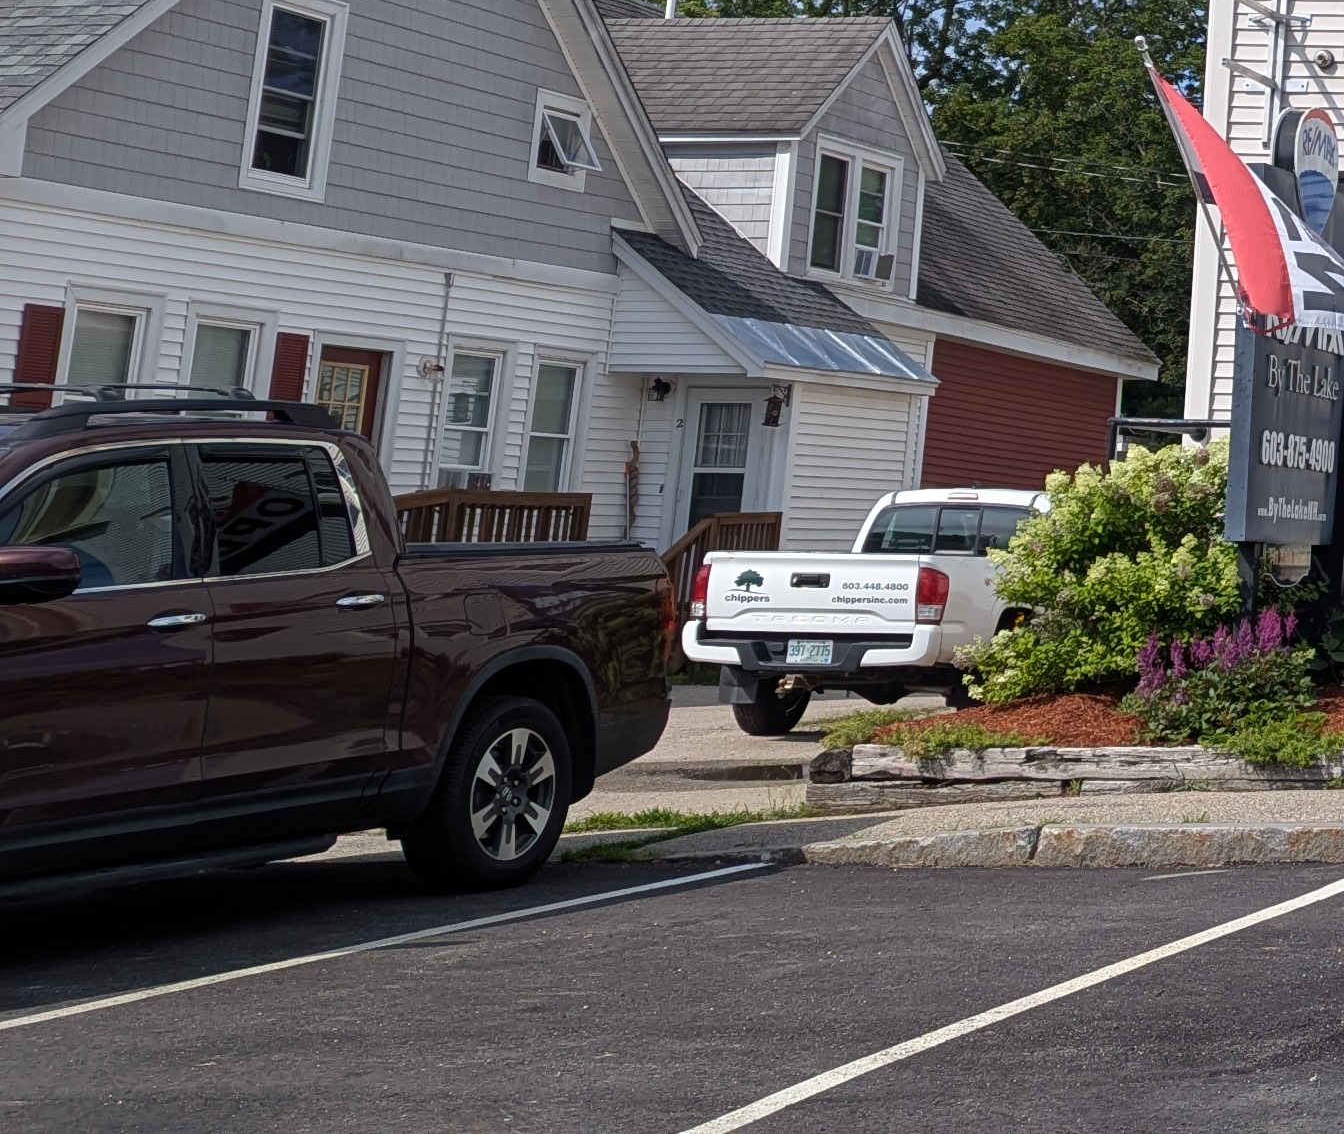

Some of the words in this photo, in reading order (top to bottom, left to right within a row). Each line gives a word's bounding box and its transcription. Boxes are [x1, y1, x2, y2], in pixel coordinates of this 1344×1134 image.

[1302, 126, 1336, 167] RE/MAX
[1268, 354, 1285, 398] By
[1288, 359, 1310, 395] The
[1313, 365, 1339, 401] Lake
[676, 418, 684, 428] 2
[1262, 429, 1335, 474] 603-875-4900
[842, 582, 909, 591] 603.448.4800
[725, 594, 770, 604] chippers
[831, 595, 908, 604] chippersinc.com
[751, 614, 872, 625] TACOMA
[789, 645, 806, 656] 397
[809, 645, 831, 656] 2775
